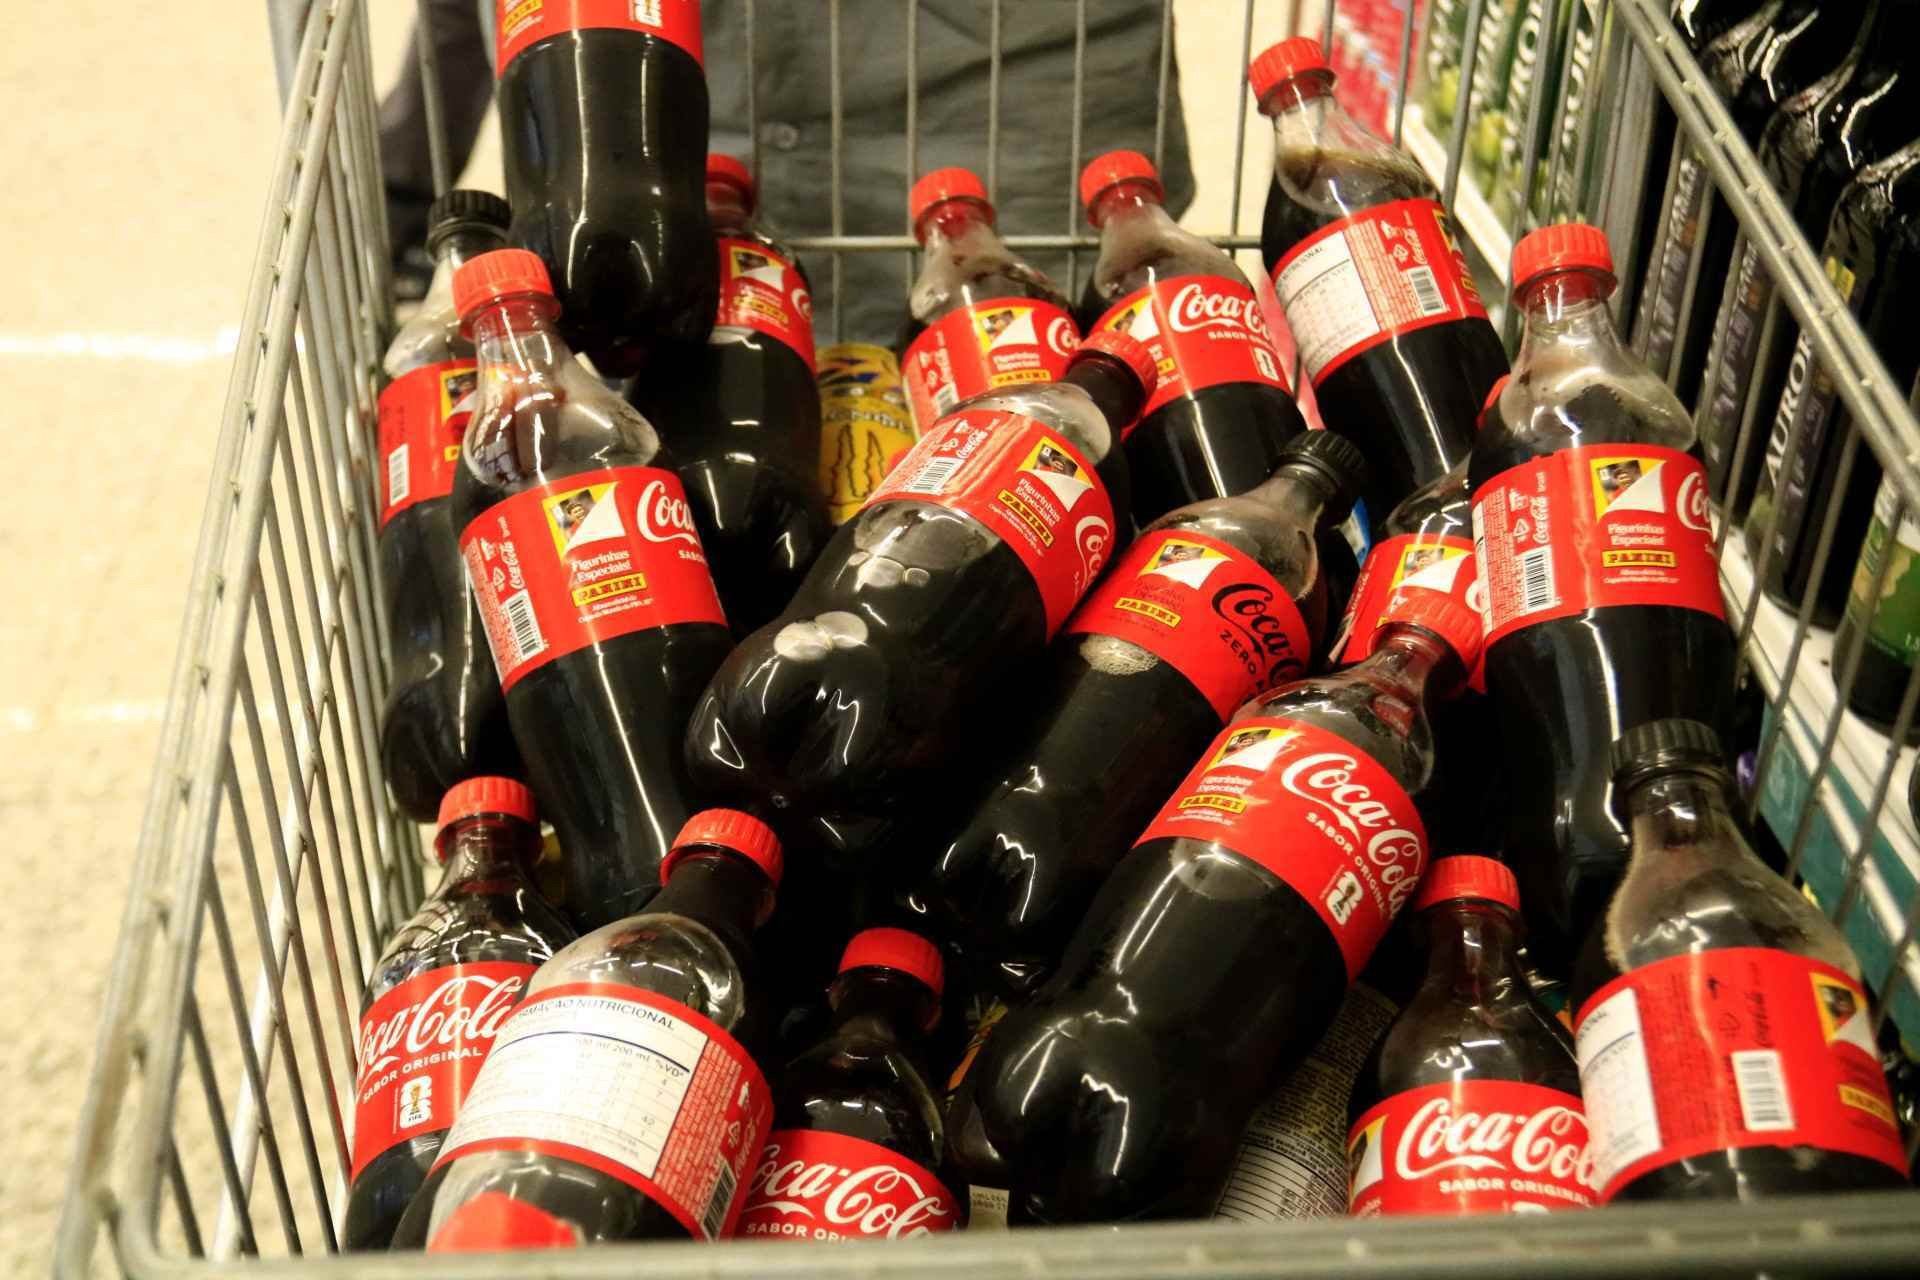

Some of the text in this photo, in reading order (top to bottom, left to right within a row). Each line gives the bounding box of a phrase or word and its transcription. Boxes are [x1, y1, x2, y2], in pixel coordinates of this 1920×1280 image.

[1168, 283, 1271, 341] Coca-C
[1604, 551, 1674, 566] PANINI
[576, 575, 644, 604] PANINI
[1115, 598, 1180, 626] PANINI
[1220, 630, 1257, 675] ZERO
[1305, 812, 1354, 857] SABOR
[402, 1046, 483, 1074] ORIGINAL
[1439, 1177, 1505, 1194] SABOR
[746, 1222, 808, 1238] SABOR
